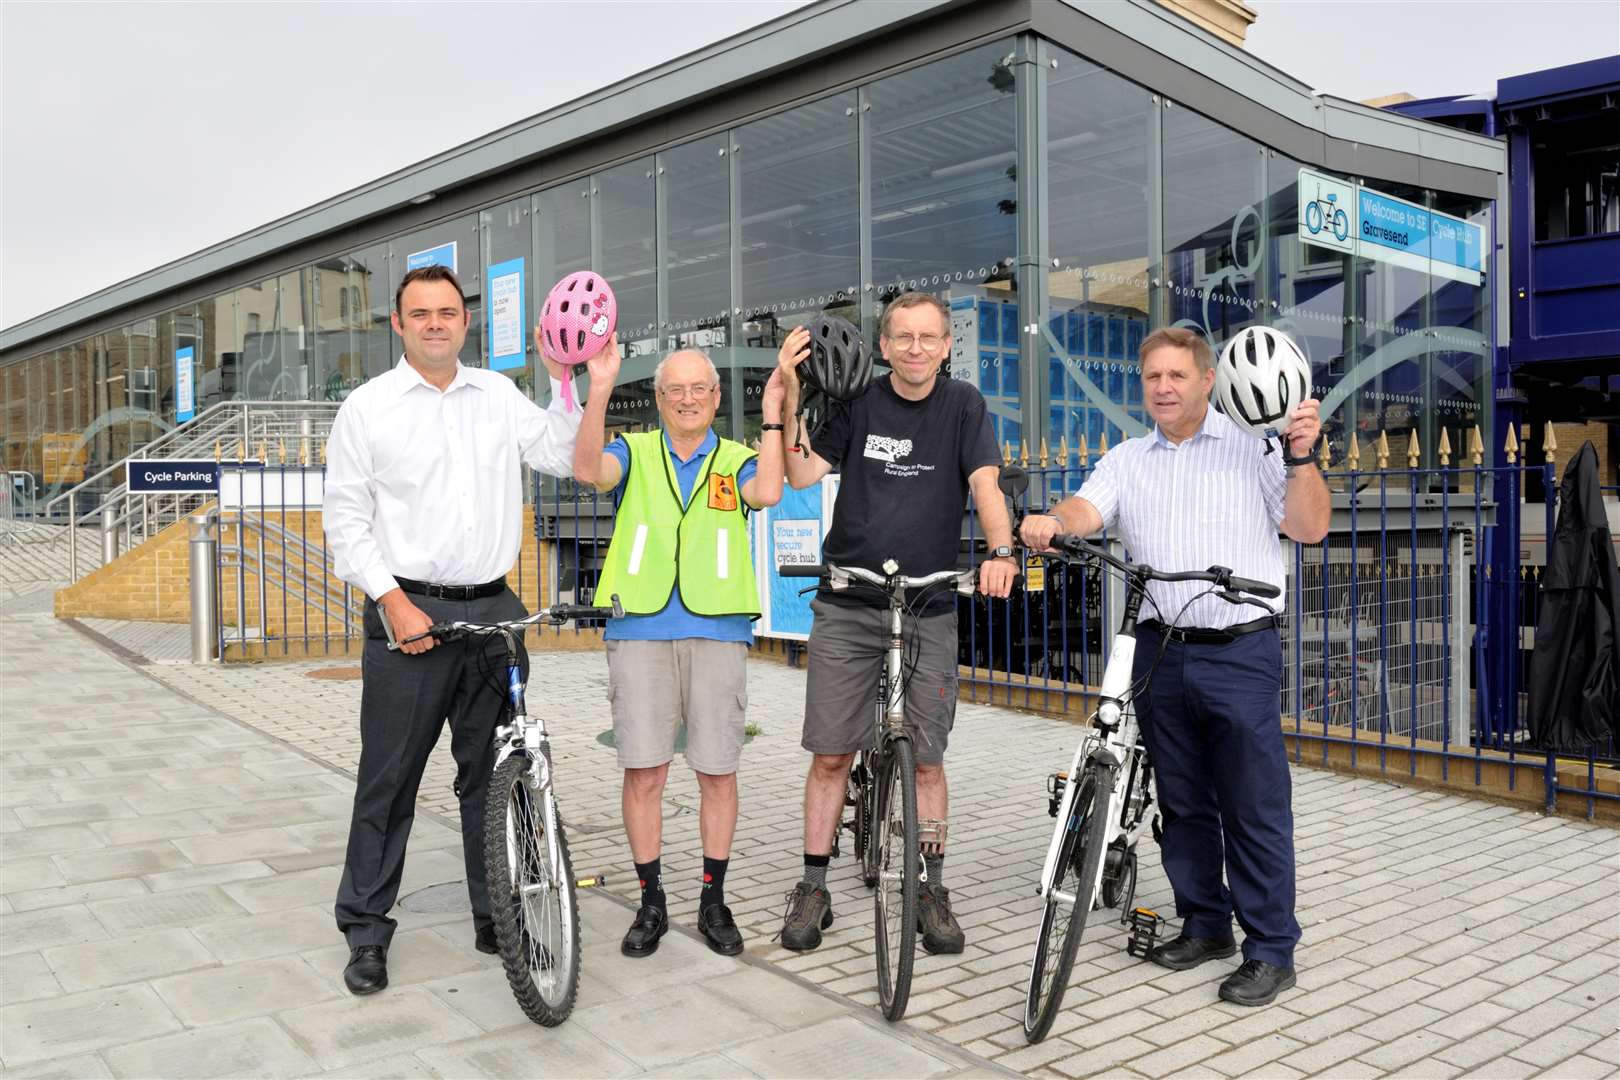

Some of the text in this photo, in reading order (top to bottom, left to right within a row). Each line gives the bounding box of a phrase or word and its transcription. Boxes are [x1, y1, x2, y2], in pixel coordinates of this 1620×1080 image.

[1362, 197, 1406, 224] Welcome
[1407, 211, 1416, 228] to
[1416, 214, 1427, 231] SE
[1432, 219, 1456, 239] Cycle
[1362, 220, 1409, 246] Gravesend
[884, 467, 897, 475] Rural
[885, 462, 911, 471] Campaign
[917, 463, 935, 471] Protect
[144, 471, 212, 484] Cycle Parking
[776, 527, 813, 537] Your new
[777, 552, 816, 565] cycle hub
